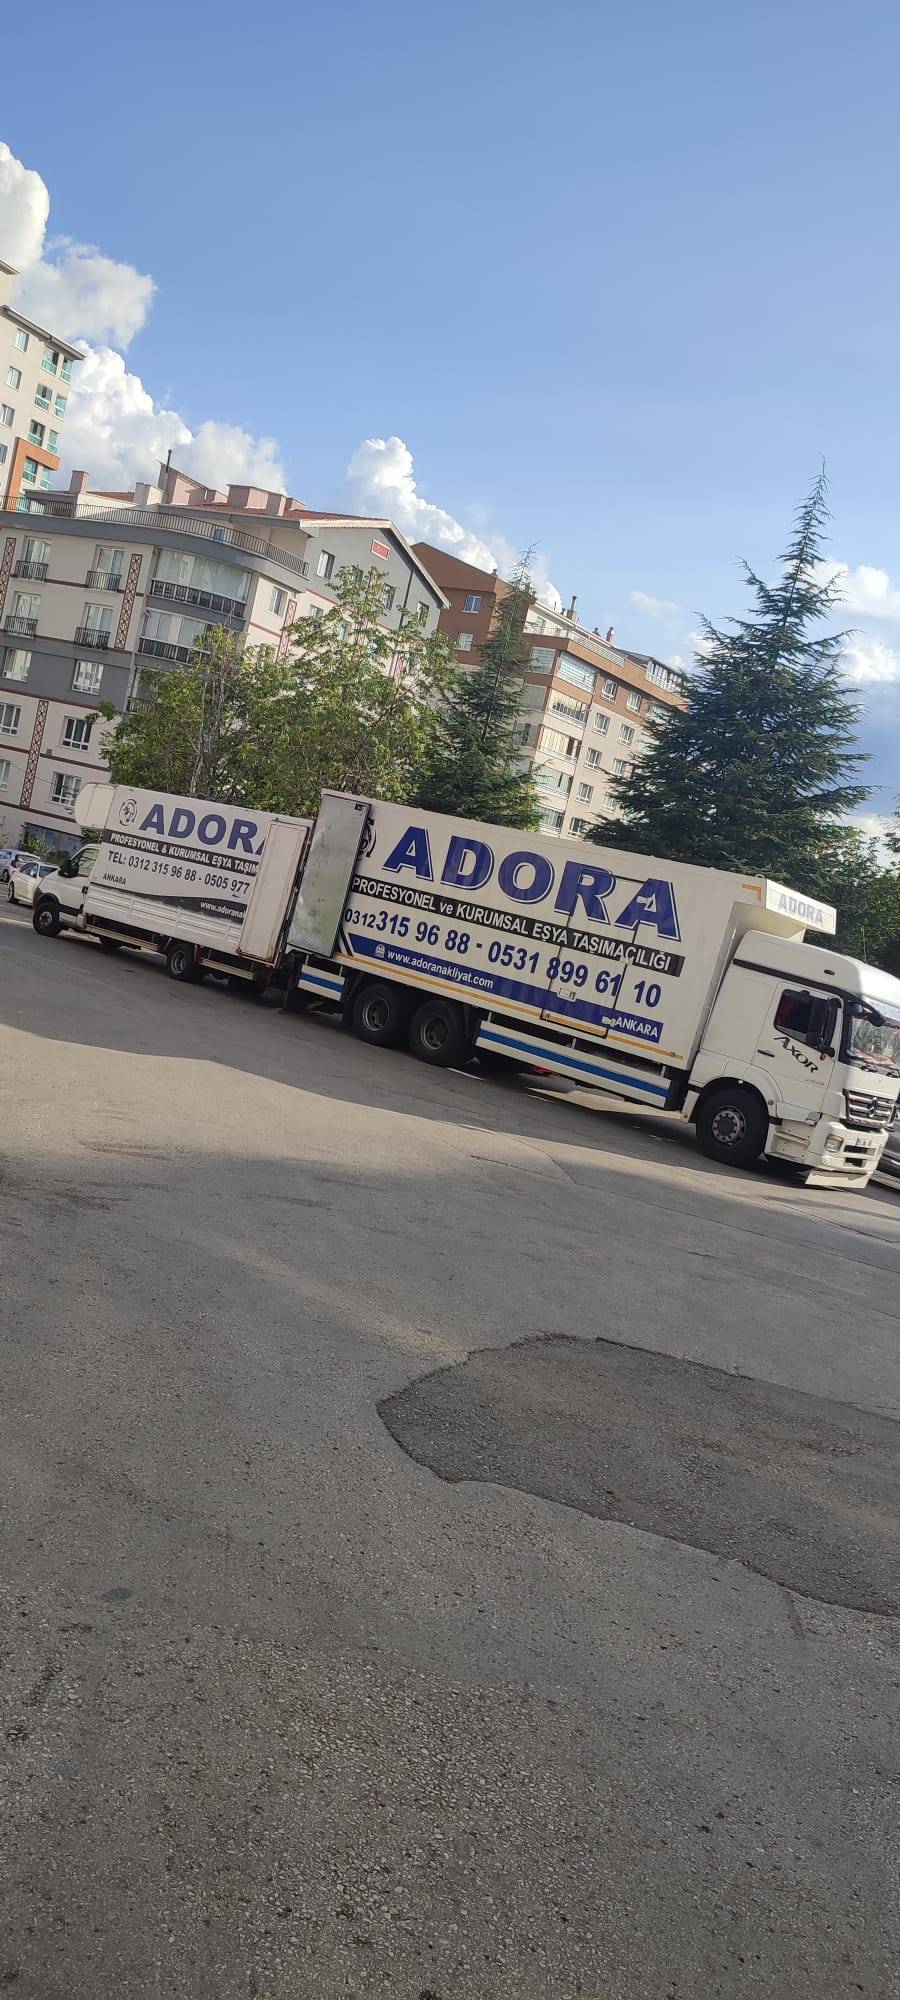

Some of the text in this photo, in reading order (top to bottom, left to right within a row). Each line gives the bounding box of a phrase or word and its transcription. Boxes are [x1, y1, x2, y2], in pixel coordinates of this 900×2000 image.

[138, 803, 266, 856] ADOR
[110, 833, 160, 853] PROFESYONEL
[161, 844, 168, 854] &
[168, 845, 210, 863] KURUMSAL
[211, 855, 232, 869] EŞYA
[102, 872, 127, 886] ANKARA
[108, 850, 127, 865] TEL:
[128, 855, 151, 871] 0312
[151, 861, 170, 876] 315
[170, 865, 183, 879] 96
[184, 868, 197, 882] 88
[204, 873, 230, 889] 0505
[230, 879, 250, 894] 977
[381, 825, 682, 943] ADORA
[351, 877, 437, 911] PROFESYONEL
[440, 901, 454, 915] ve
[455, 903, 529, 936] KURUMSAL
[532, 922, 568, 945] EŞYA
[779, 895, 823, 925] ADORA
[344, 908, 377, 929] 0312
[375, 910, 411, 938] 315
[415, 921, 441, 946] 96
[444, 929, 471, 955] 88
[488, 941, 540, 974] 0531
[546, 956, 589, 988] 899
[595, 970, 622, 997] 61
[633, 980, 662, 1008] 10
[387, 948, 495, 989] www.adoranakliyat.com
[614, 1016, 659, 1038] ANKARA
[773, 1036, 819, 1074] AXOR
